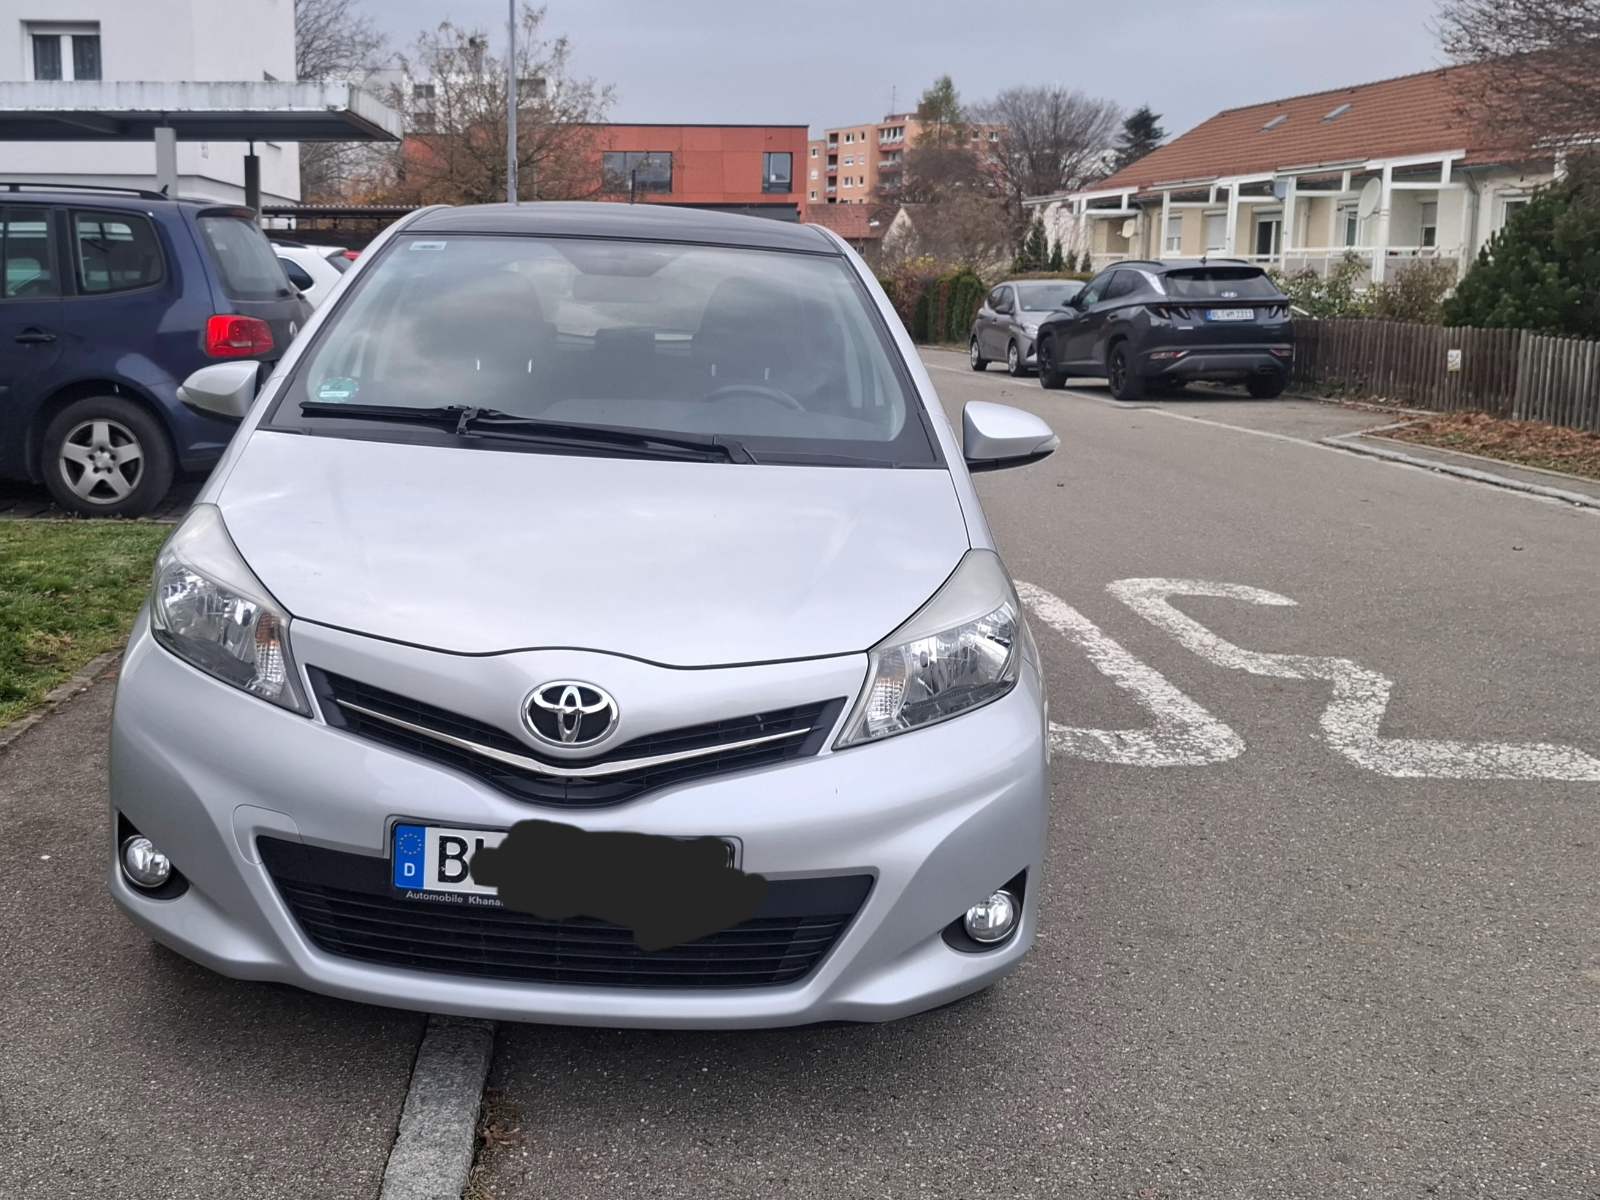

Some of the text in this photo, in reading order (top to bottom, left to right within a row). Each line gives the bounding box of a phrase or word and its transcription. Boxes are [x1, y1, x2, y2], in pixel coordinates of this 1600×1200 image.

[404, 862, 415, 876] D
[406, 890, 504, 907] Automobile Khana
